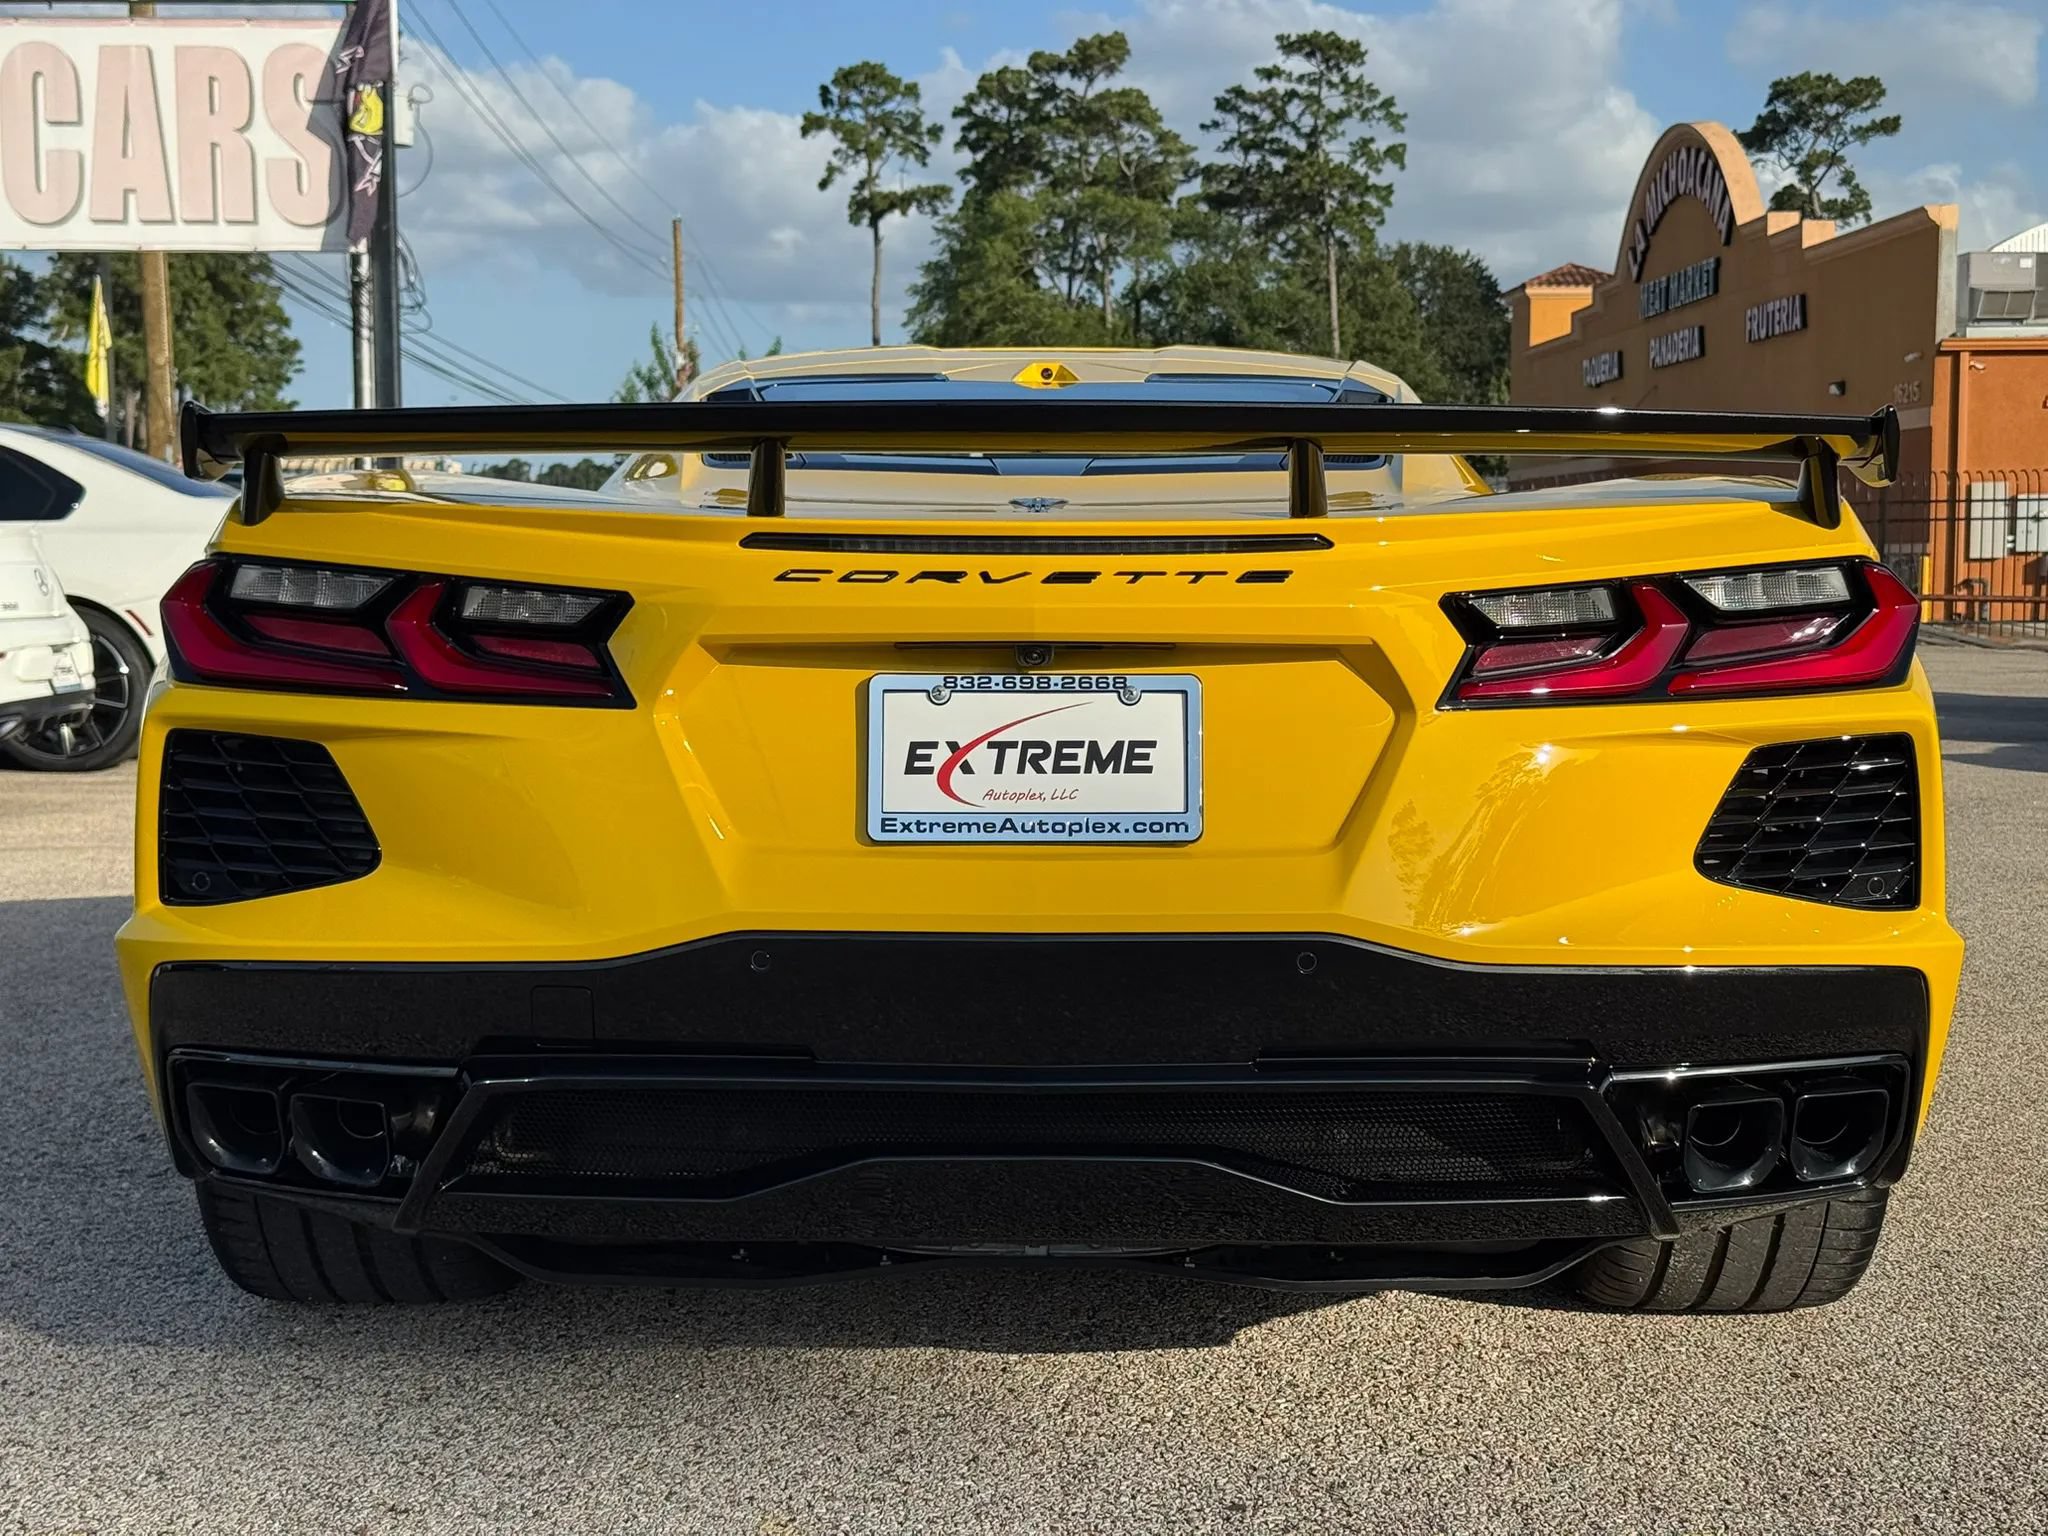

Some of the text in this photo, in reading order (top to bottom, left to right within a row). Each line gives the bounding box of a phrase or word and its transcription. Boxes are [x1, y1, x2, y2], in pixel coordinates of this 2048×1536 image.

[0, 41, 343, 226] CARS
[1628, 146, 1731, 282] LA MICHOACANA
[1639, 256, 1717, 320] MEAT MARKET
[1746, 294, 1802, 343] FRUTERIA
[1649, 326, 1700, 368] PANADERIA
[1893, 380, 1921, 403] 16215
[773, 569, 1294, 584] CORVETTE
[943, 676, 1127, 690] 832-698-2668
[904, 740, 1157, 775] EXTREME
[982, 788, 1080, 804] Autoplex, LLC
[881, 817, 1189, 837] ExtremeAutoplex.com
